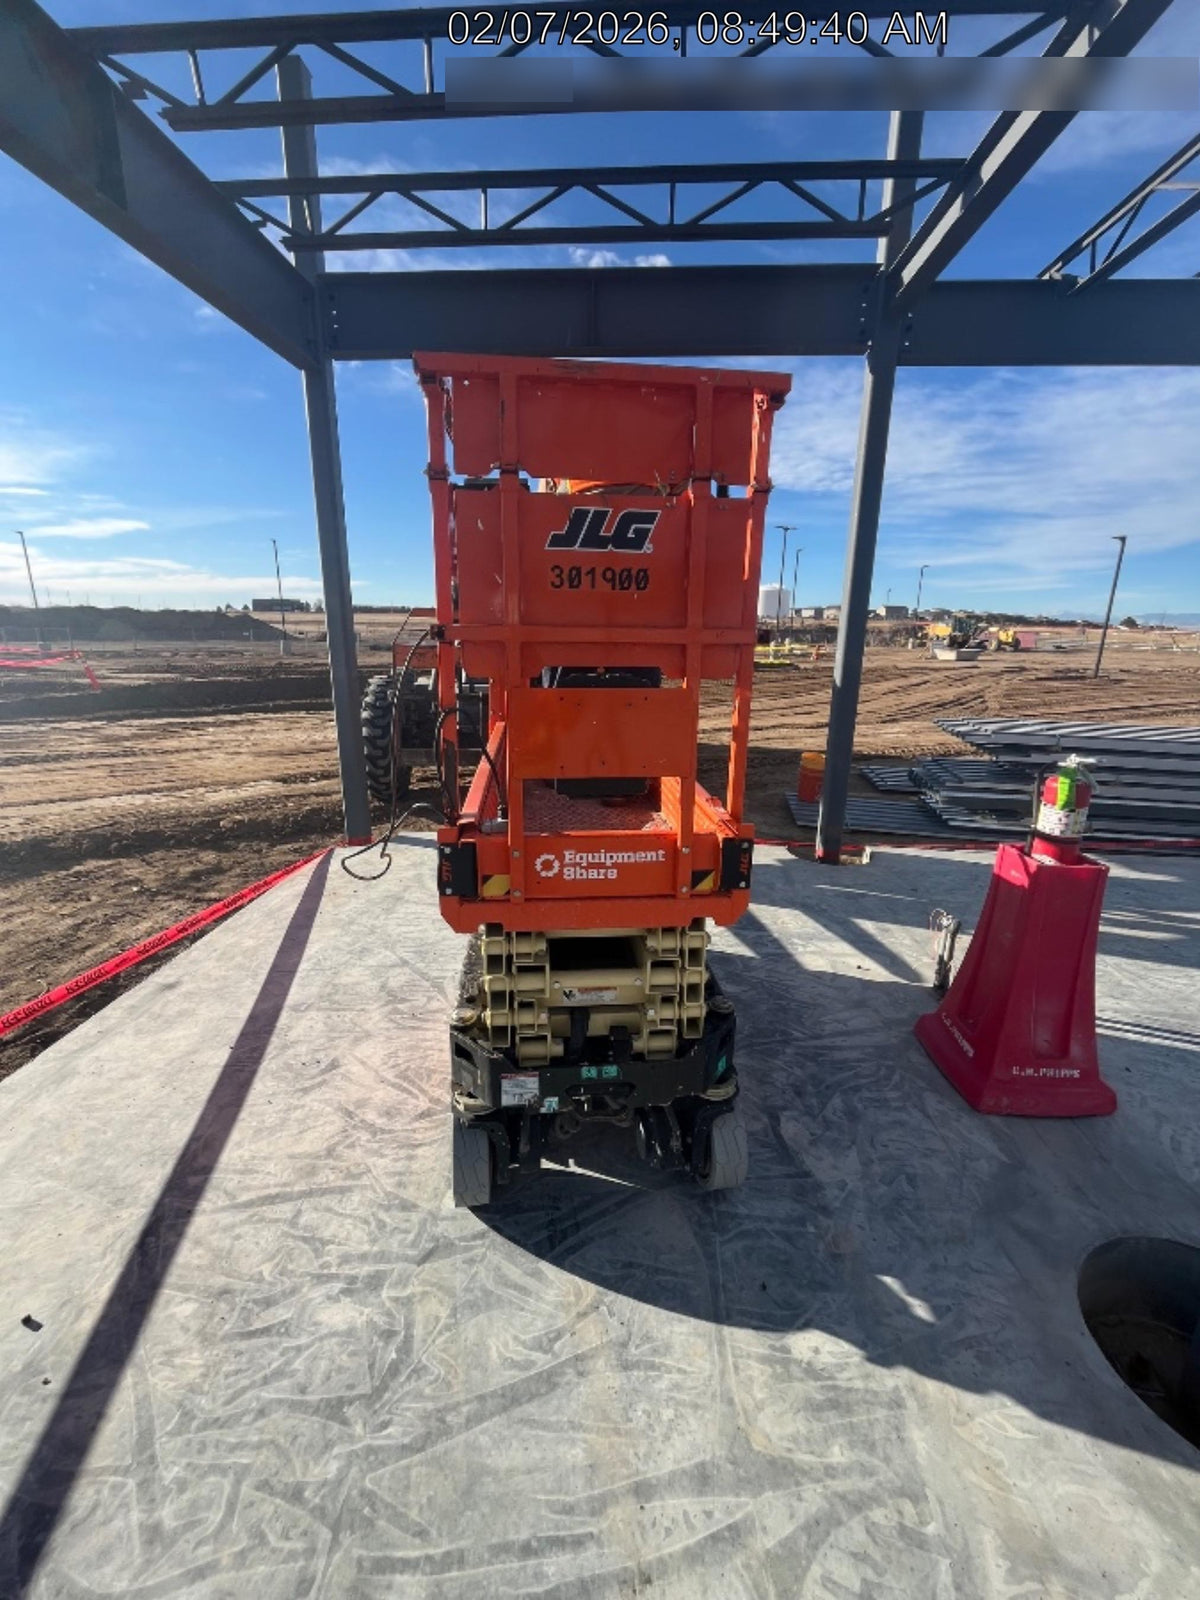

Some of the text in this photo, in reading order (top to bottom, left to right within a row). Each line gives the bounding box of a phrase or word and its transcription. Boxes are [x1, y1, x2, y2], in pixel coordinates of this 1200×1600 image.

[545, 507, 661, 552] JLG
[550, 565, 649, 591] 301900
[563, 850, 666, 866] Equipment
[563, 867, 617, 880] Share
